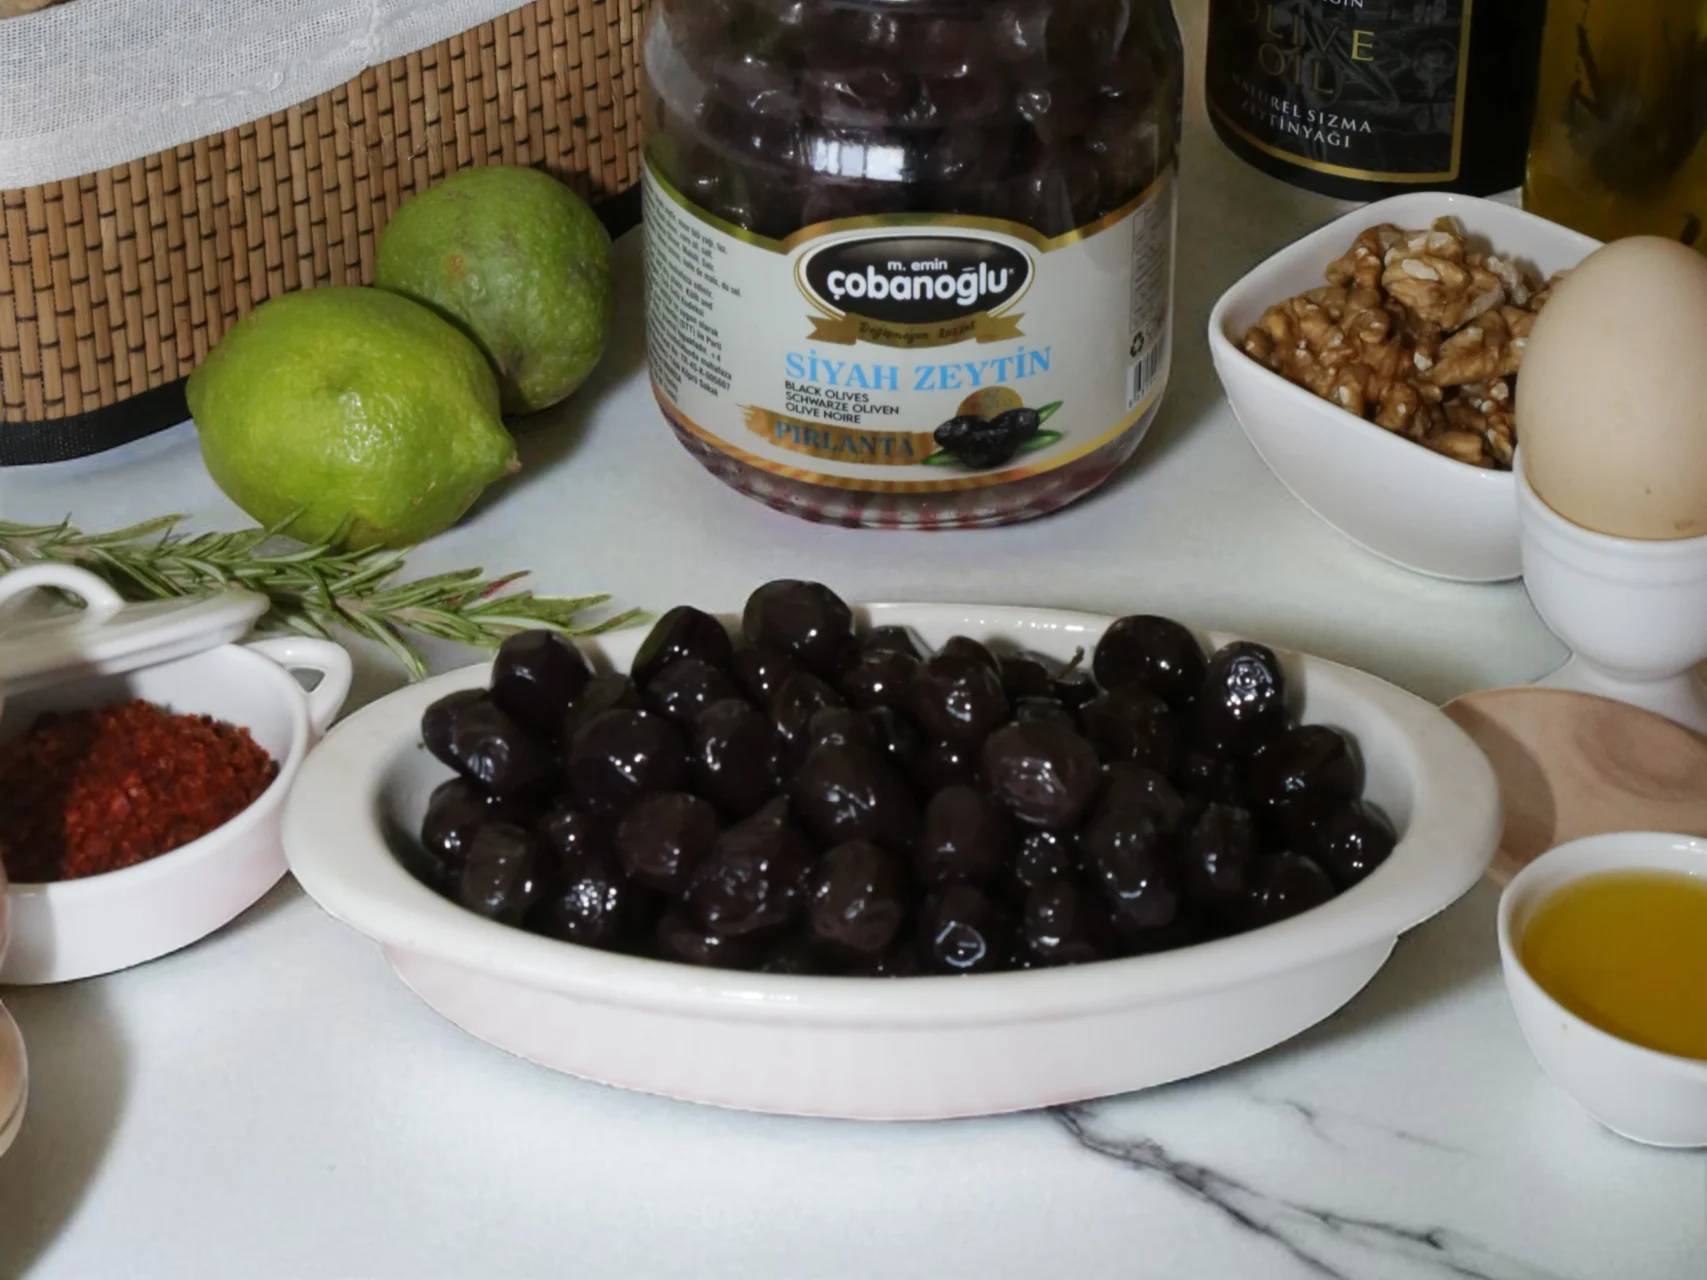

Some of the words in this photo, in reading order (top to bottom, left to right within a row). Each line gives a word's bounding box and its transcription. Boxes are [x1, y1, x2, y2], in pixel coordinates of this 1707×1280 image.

[1258, 42, 1335, 95] OIL
[1307, 109, 1372, 134] SIZMA
[887, 259, 907, 272] m.
[910, 257, 948, 272] emin
[827, 261, 1008, 307] çobanoğlu
[784, 347, 899, 392] SİYAH
[912, 345, 1051, 392] ZEYTİN
[785, 380, 822, 397] BLACK
[825, 388, 869, 403] OLIVES
[785, 391, 849, 412] SCHWARZE
[852, 403, 899, 416] OLIVEN
[785, 402, 820, 418] OLIVE
[823, 410, 861, 424] NOIRE
[775, 420, 914, 458] PIRLANTA
